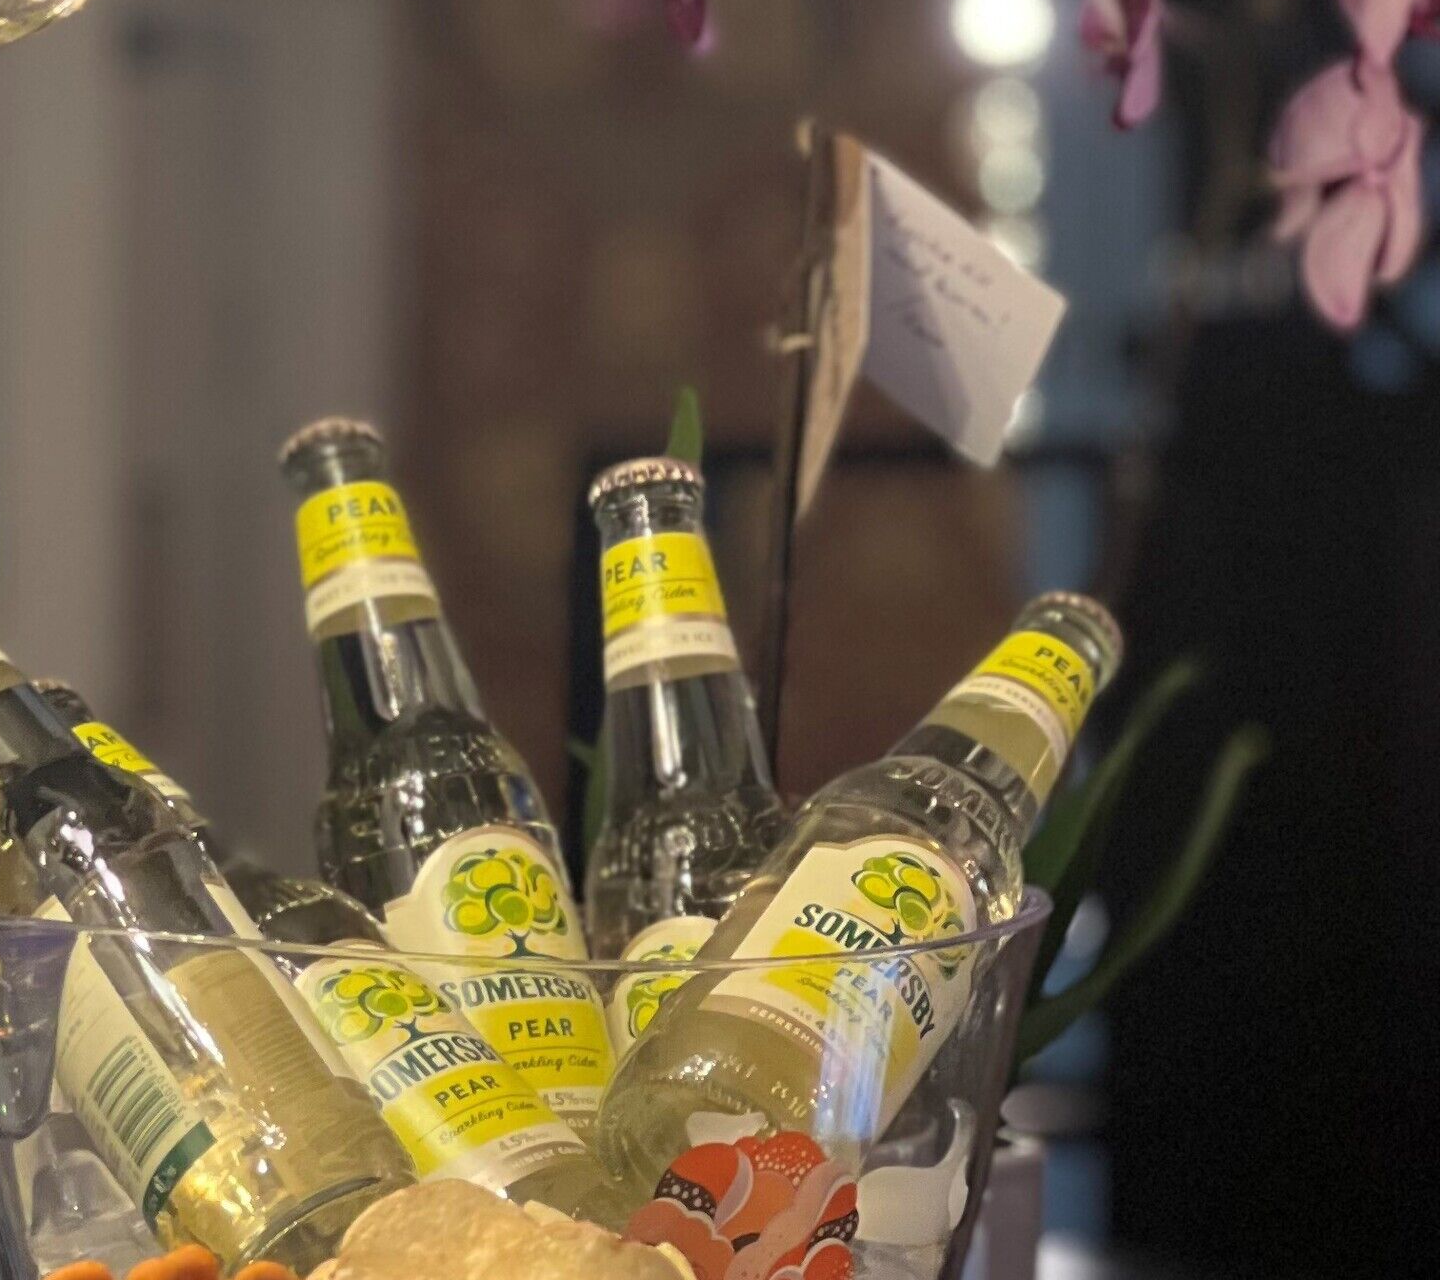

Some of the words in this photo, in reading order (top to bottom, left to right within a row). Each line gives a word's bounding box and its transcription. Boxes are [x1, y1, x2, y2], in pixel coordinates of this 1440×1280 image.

[836, 967, 892, 1022] PEAR
[509, 1018, 574, 1040] PEAR
[367, 1034, 497, 1110] OMERSB
[435, 1075, 500, 1108] PEAR
